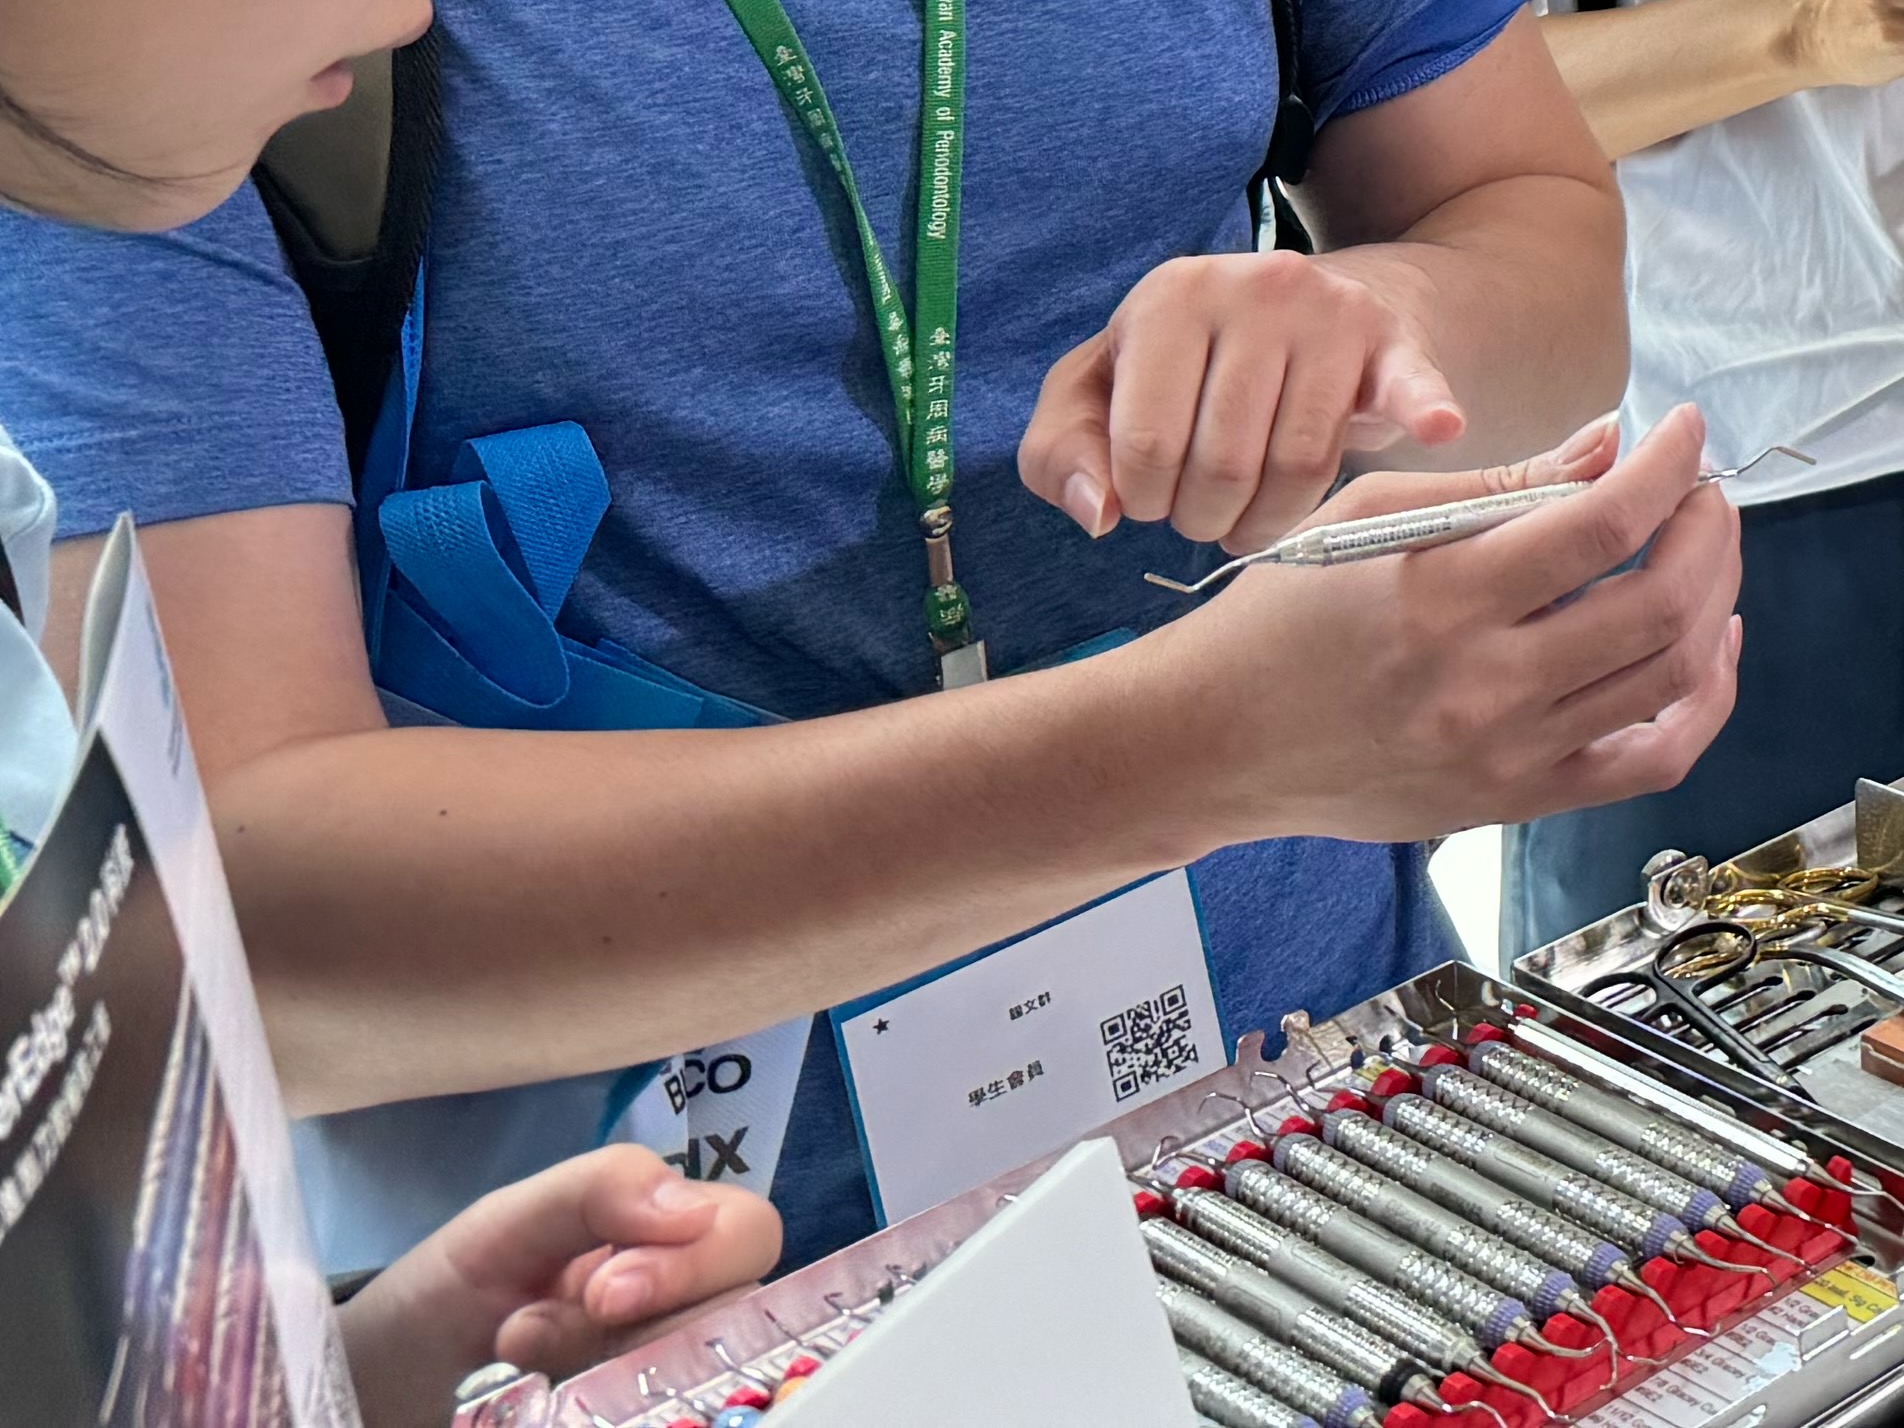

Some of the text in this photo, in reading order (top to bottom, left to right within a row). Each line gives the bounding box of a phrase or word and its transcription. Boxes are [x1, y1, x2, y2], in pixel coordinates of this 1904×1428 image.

[939, 30, 957, 98] Academy
[937, 106, 955, 124] of
[925, 128, 956, 240] Periodontology
[967, 1059, 1045, 1107] 學生會員
